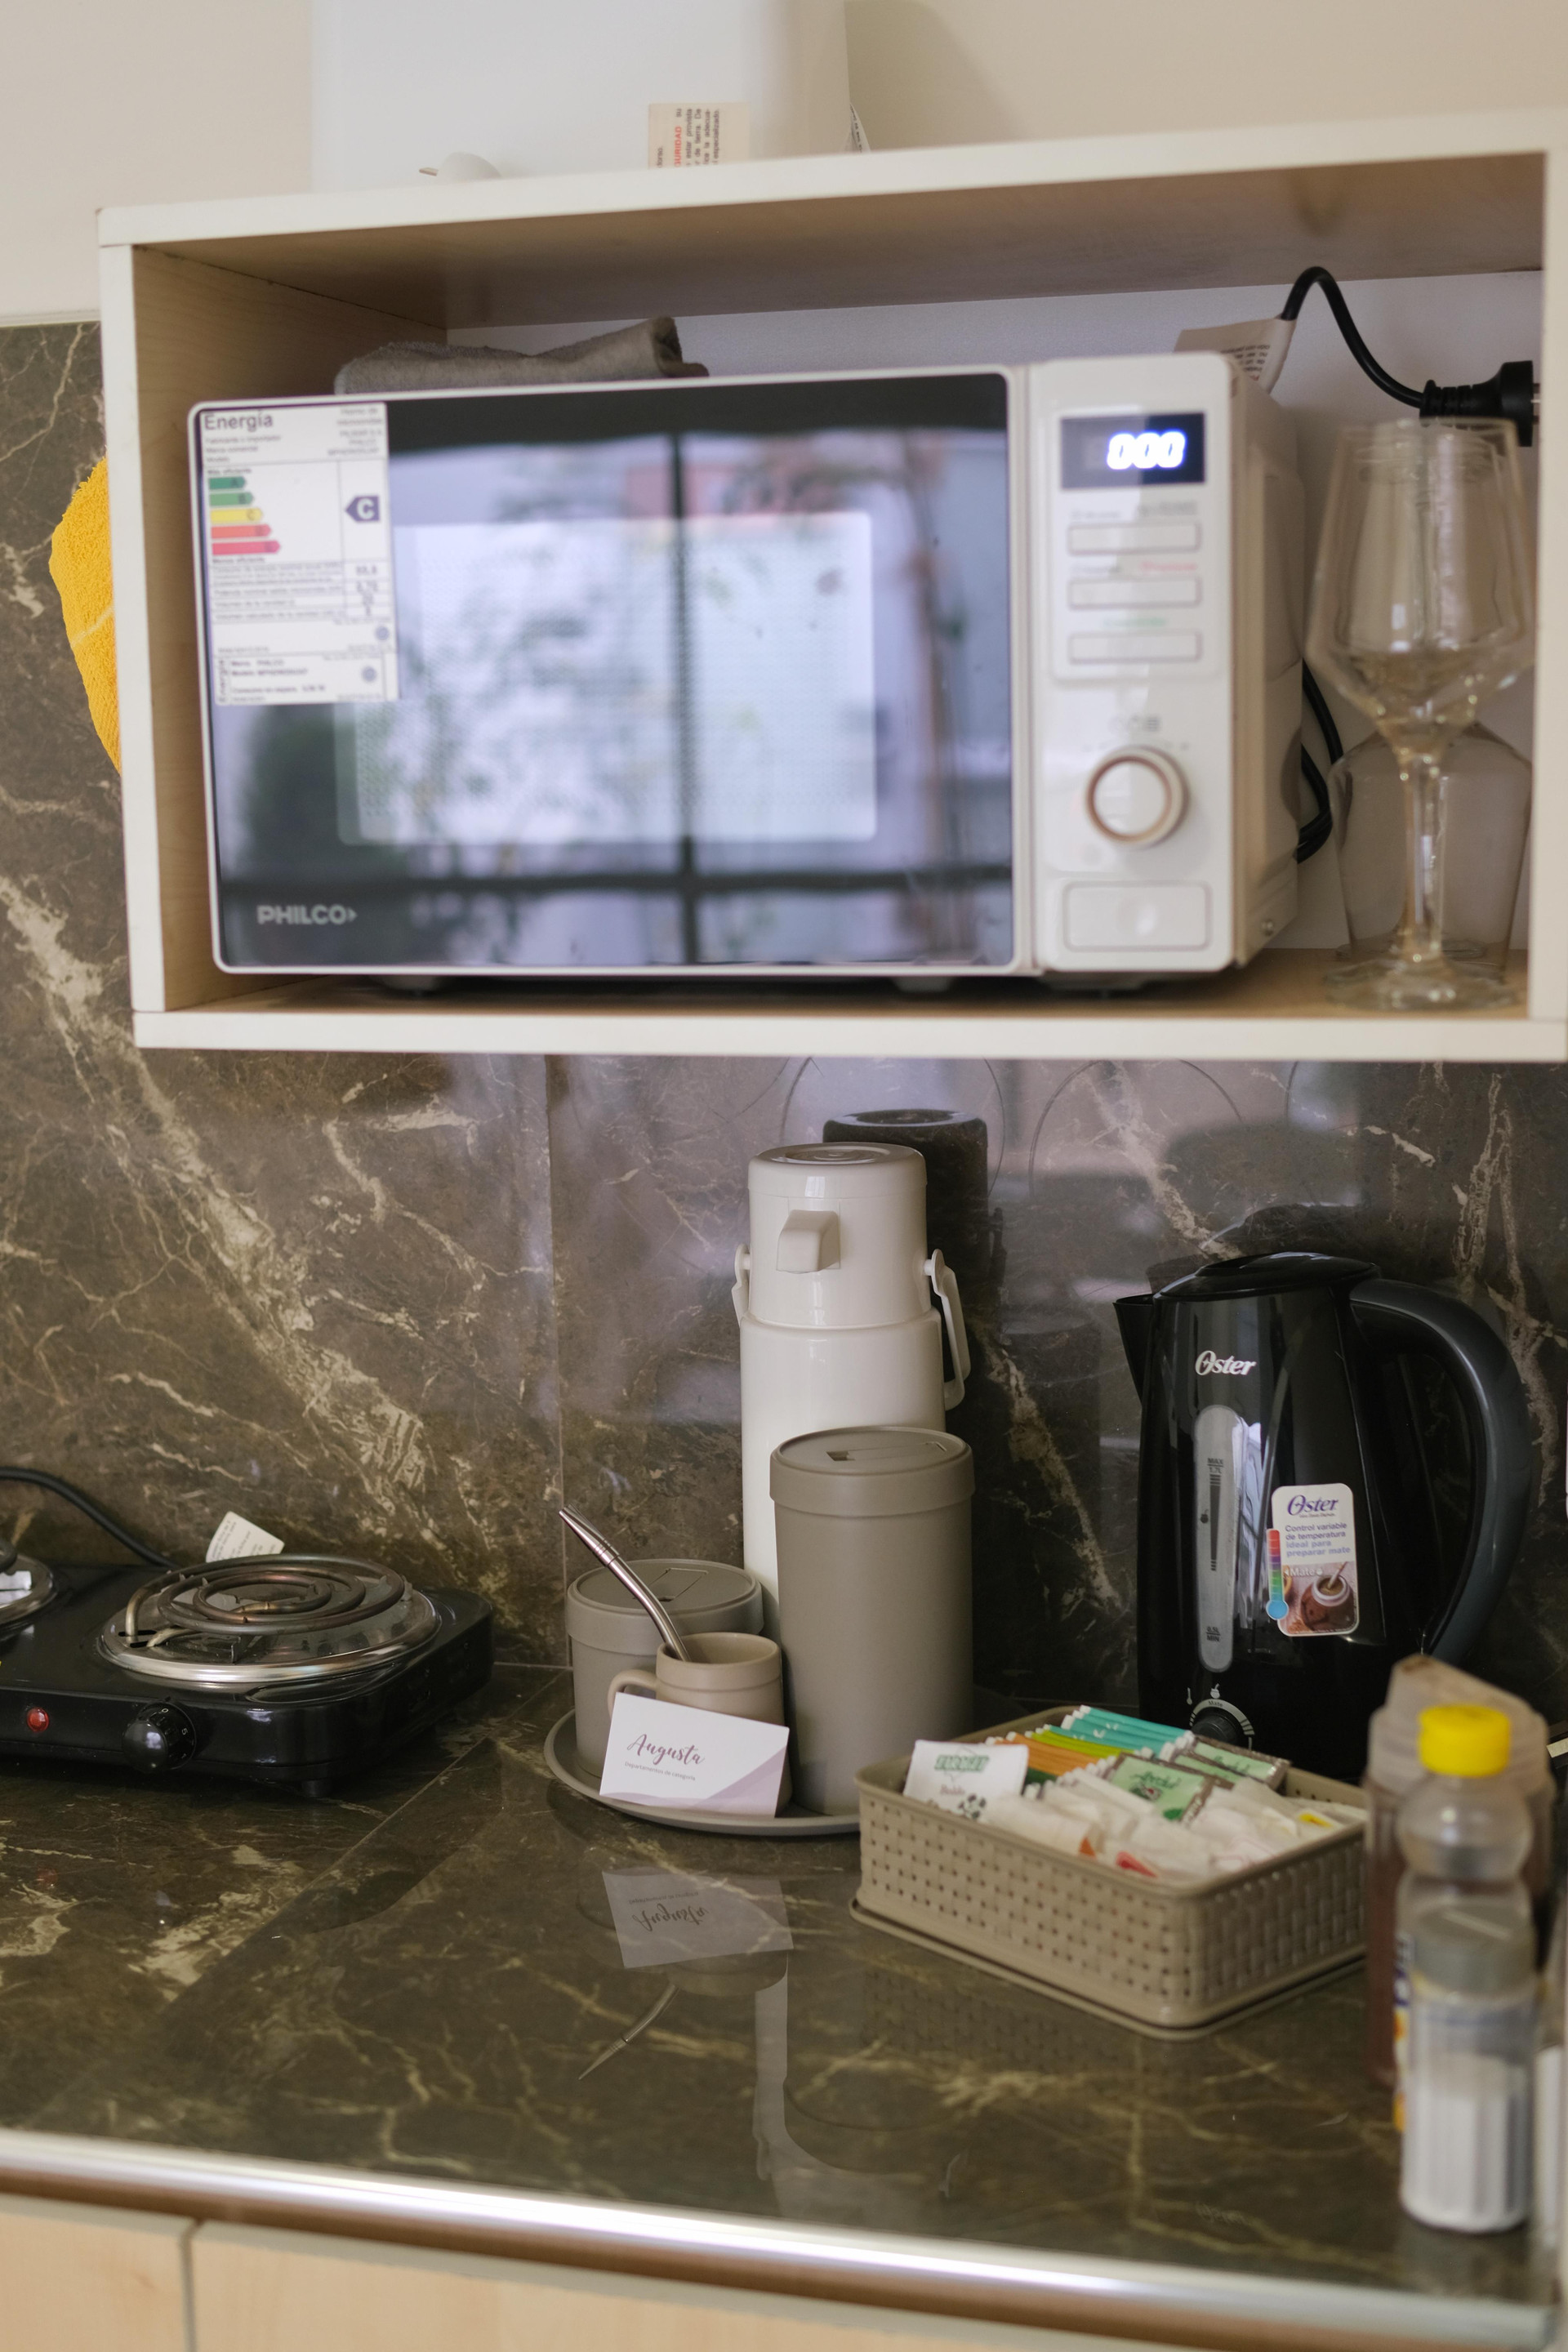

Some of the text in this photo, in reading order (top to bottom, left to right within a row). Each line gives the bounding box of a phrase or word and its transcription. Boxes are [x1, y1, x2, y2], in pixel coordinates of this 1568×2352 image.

[694, 109, 701, 119] De
[204, 409, 274, 432] Energía
[357, 497, 375, 519] C
[257, 904, 346, 924] PHILCO
[1196, 1350, 1256, 1375] Oster
[1287, 1494, 1339, 1515] Oster
[1317, 1522, 1347, 1530] variable
[1298, 1531, 1346, 1539] temperatura
[1287, 1549, 1325, 1557] preparar
[1291, 1569, 1313, 1577] Mate
[627, 1734, 706, 1766] Augusta
[625, 1762, 663, 1775] Departamentos
